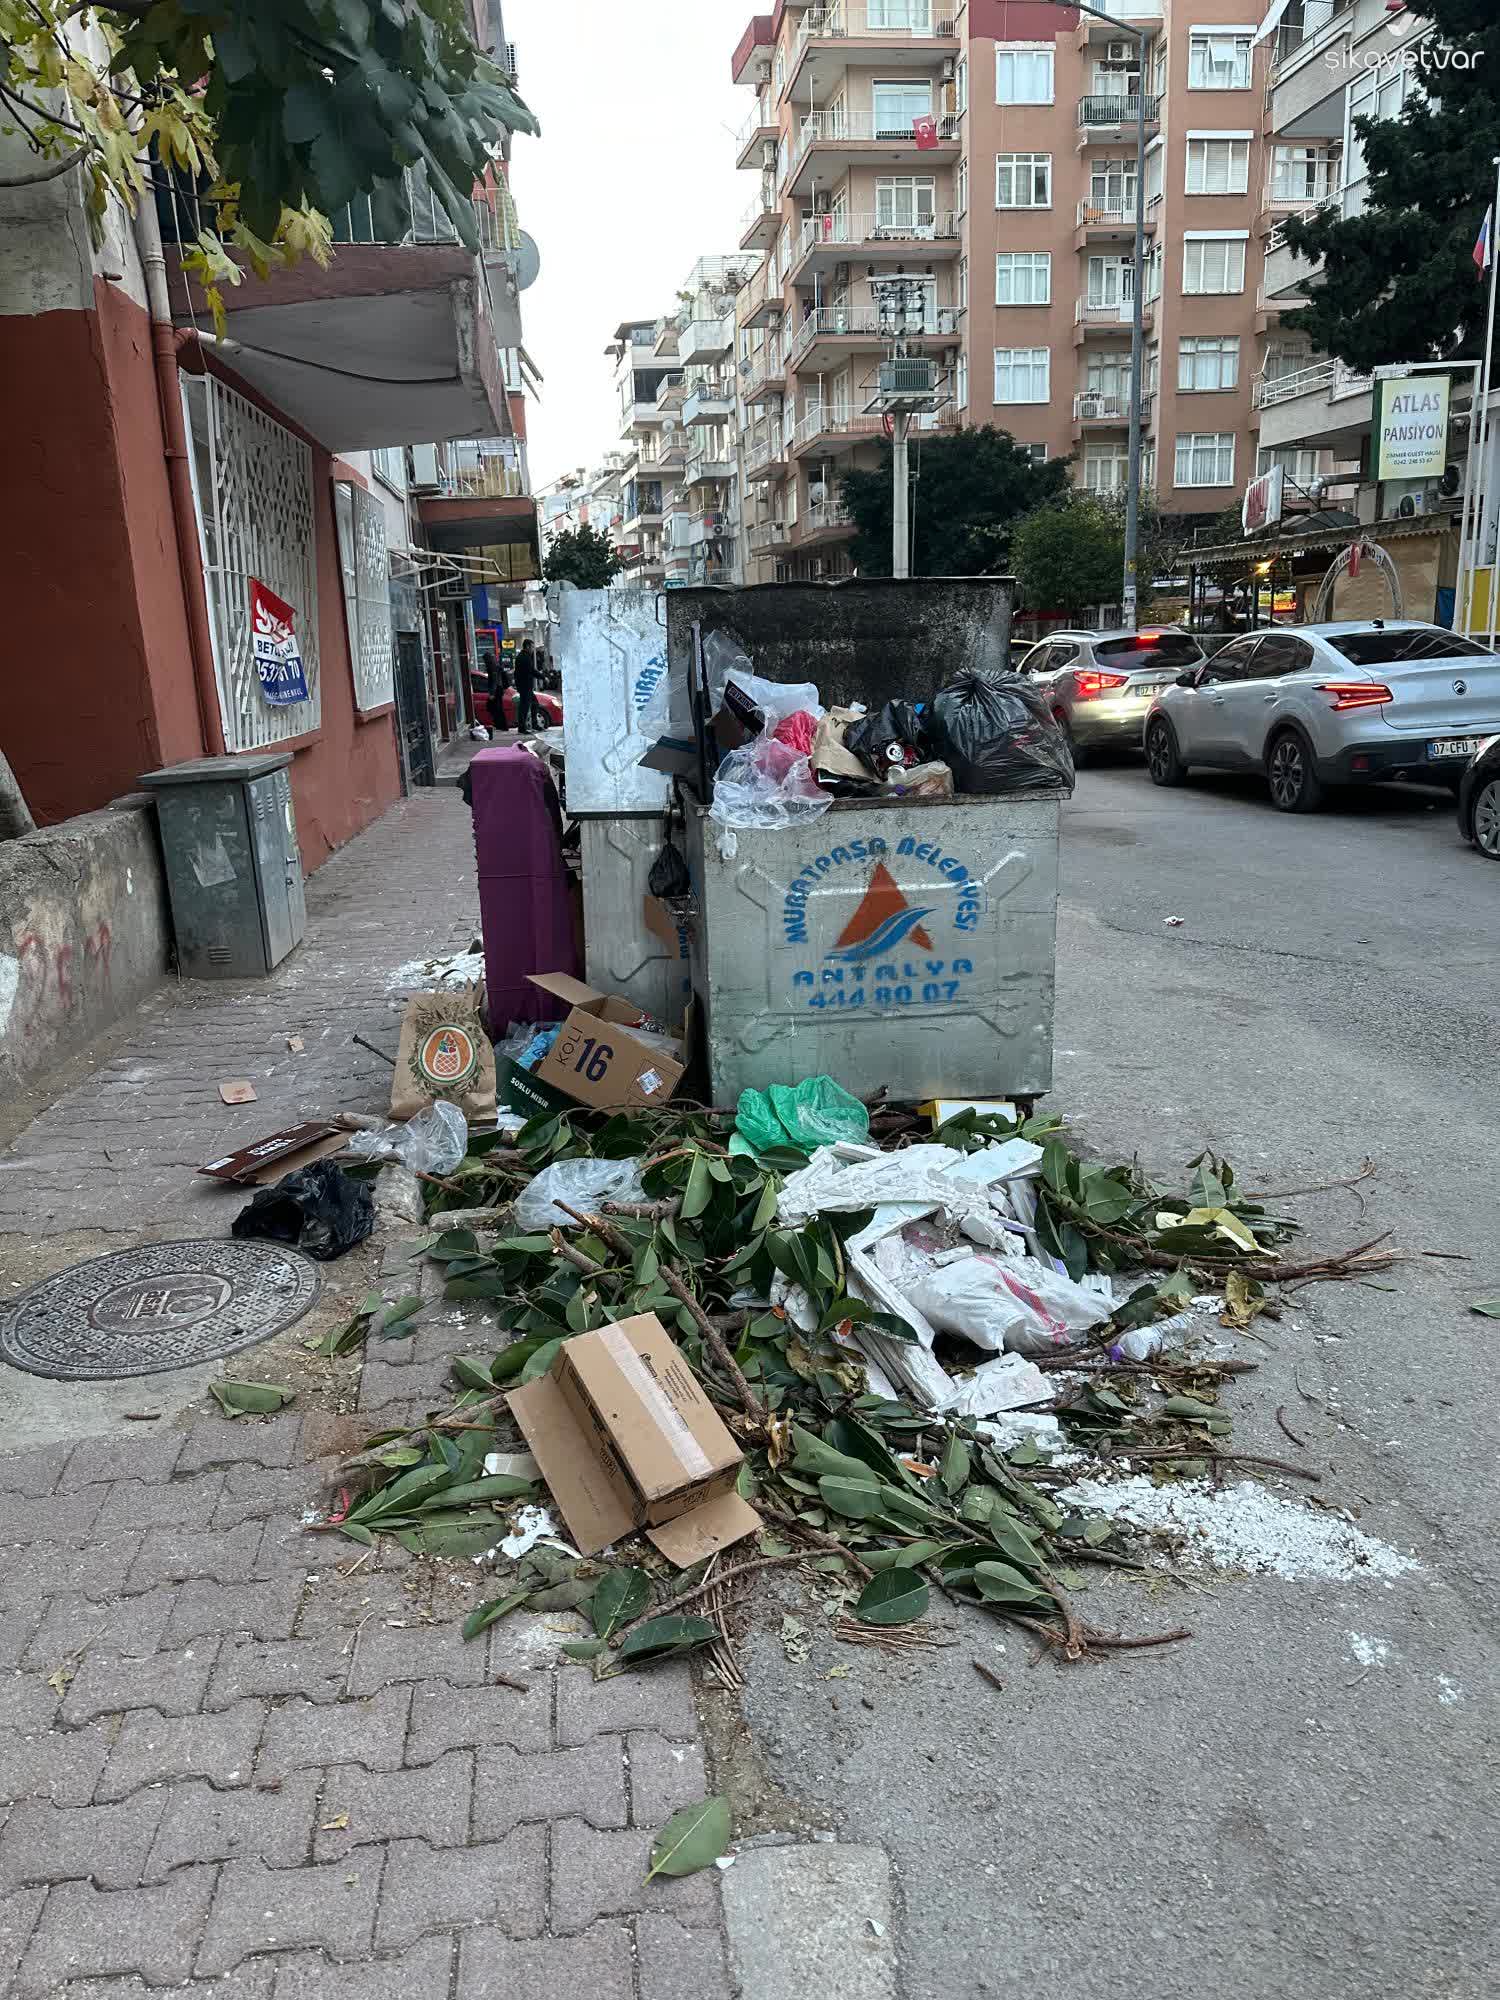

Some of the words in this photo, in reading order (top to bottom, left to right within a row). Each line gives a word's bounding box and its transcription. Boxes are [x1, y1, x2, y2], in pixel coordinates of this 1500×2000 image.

[1391, 393, 1441, 413] ATLAS
[1383, 421, 1444, 441] PANSİYON
[1433, 743, 1445, 755] 07
[1449, 741, 1468, 754] CFU
[792, 958, 975, 986] ANTALYA
[808, 987, 865, 1009] 444
[922, 980, 961, 1002] 07
[573, 1037, 614, 1082] 16
[510, 1076, 530, 1095] SOSLU
[530, 1090, 550, 1110] MISIR
